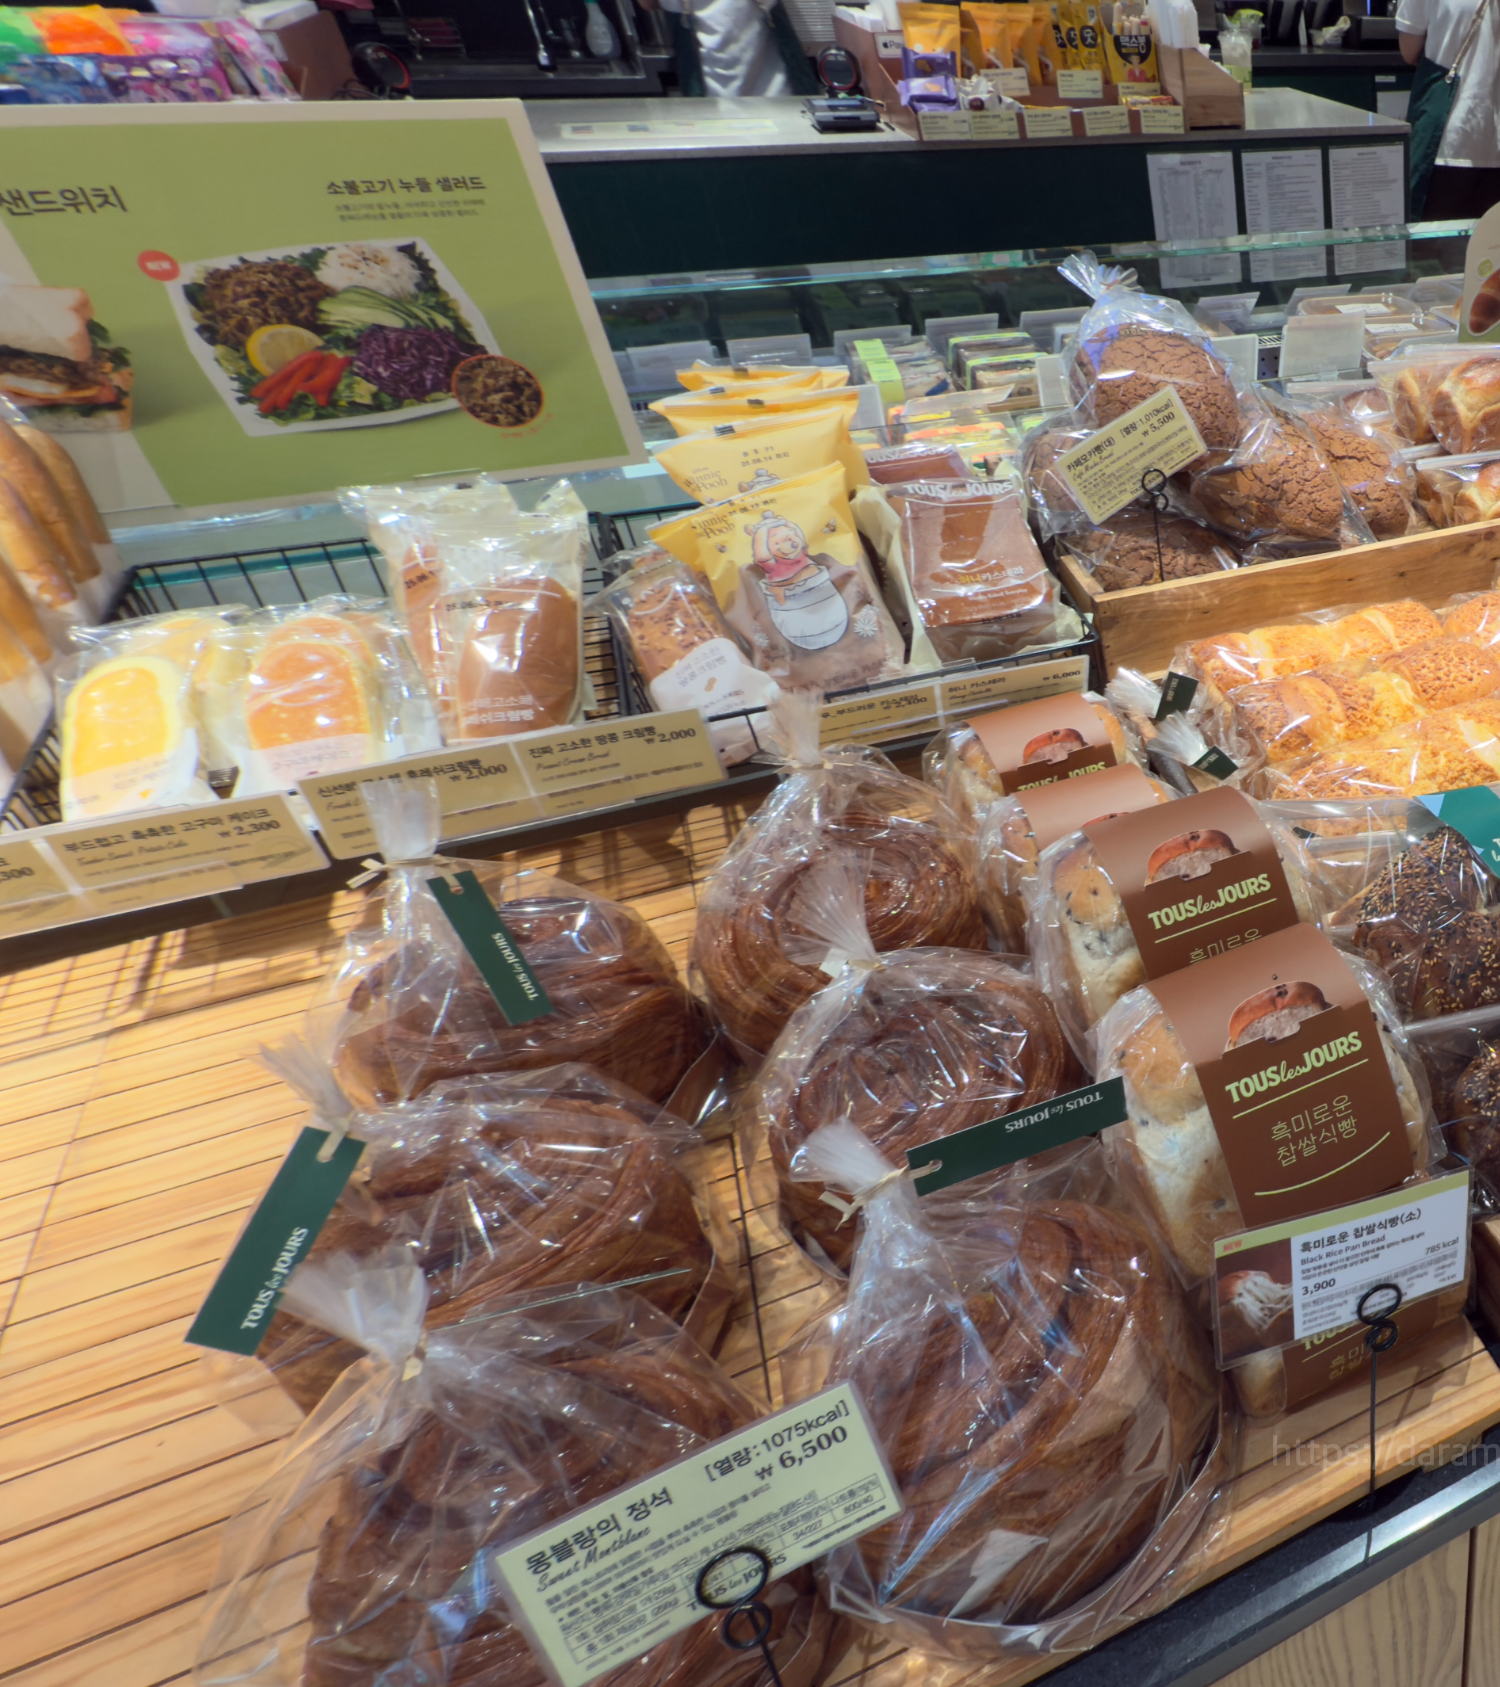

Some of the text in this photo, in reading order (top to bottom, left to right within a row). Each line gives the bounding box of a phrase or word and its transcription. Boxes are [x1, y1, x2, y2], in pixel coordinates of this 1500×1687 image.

[327, 176, 487, 196] 소불고기 누들 샐러드
[1150, 411, 1176, 434] 5,500
[1066, 436, 1116, 473] 카페모카빵(대)
[1052, 669, 1082, 681] 6,000
[527, 725, 657, 760] 진짜 고소한 땅콩 크림빵
[657, 727, 697, 744] 2,000
[464, 764, 508, 782] 2,000
[62, 832, 128, 854] 부드럽고
[228, 807, 272, 824] 케이크
[233, 818, 281, 837] 2,300
[491, 932, 520, 964] JOURS
[515, 972, 540, 1001] TOUS
[1065, 1091, 1103, 1112] TOUS
[1004, 1107, 1050, 1133] JOURS
[1270, 1094, 1353, 1142] 흑미로운
[1276, 1114, 1358, 1168] 찹쌀식빵
[1300, 1208, 1422, 1254] 흑미로운 찹쌀식빵(소)
[1425, 1236, 1460, 1255] 785 kcal
[1222, 1239, 1243, 1253] NEW
[1300, 1235, 1386, 1266] Black Rice Pan Bread
[239, 1288, 275, 1329] TOUS
[271, 1226, 309, 1275] JOURS
[1301, 1278, 1336, 1297] 3,900
[778, 1425, 849, 1470] 6,500
[526, 1513, 622, 1576] 몽블랑의
[626, 1487, 676, 1522] 정석
